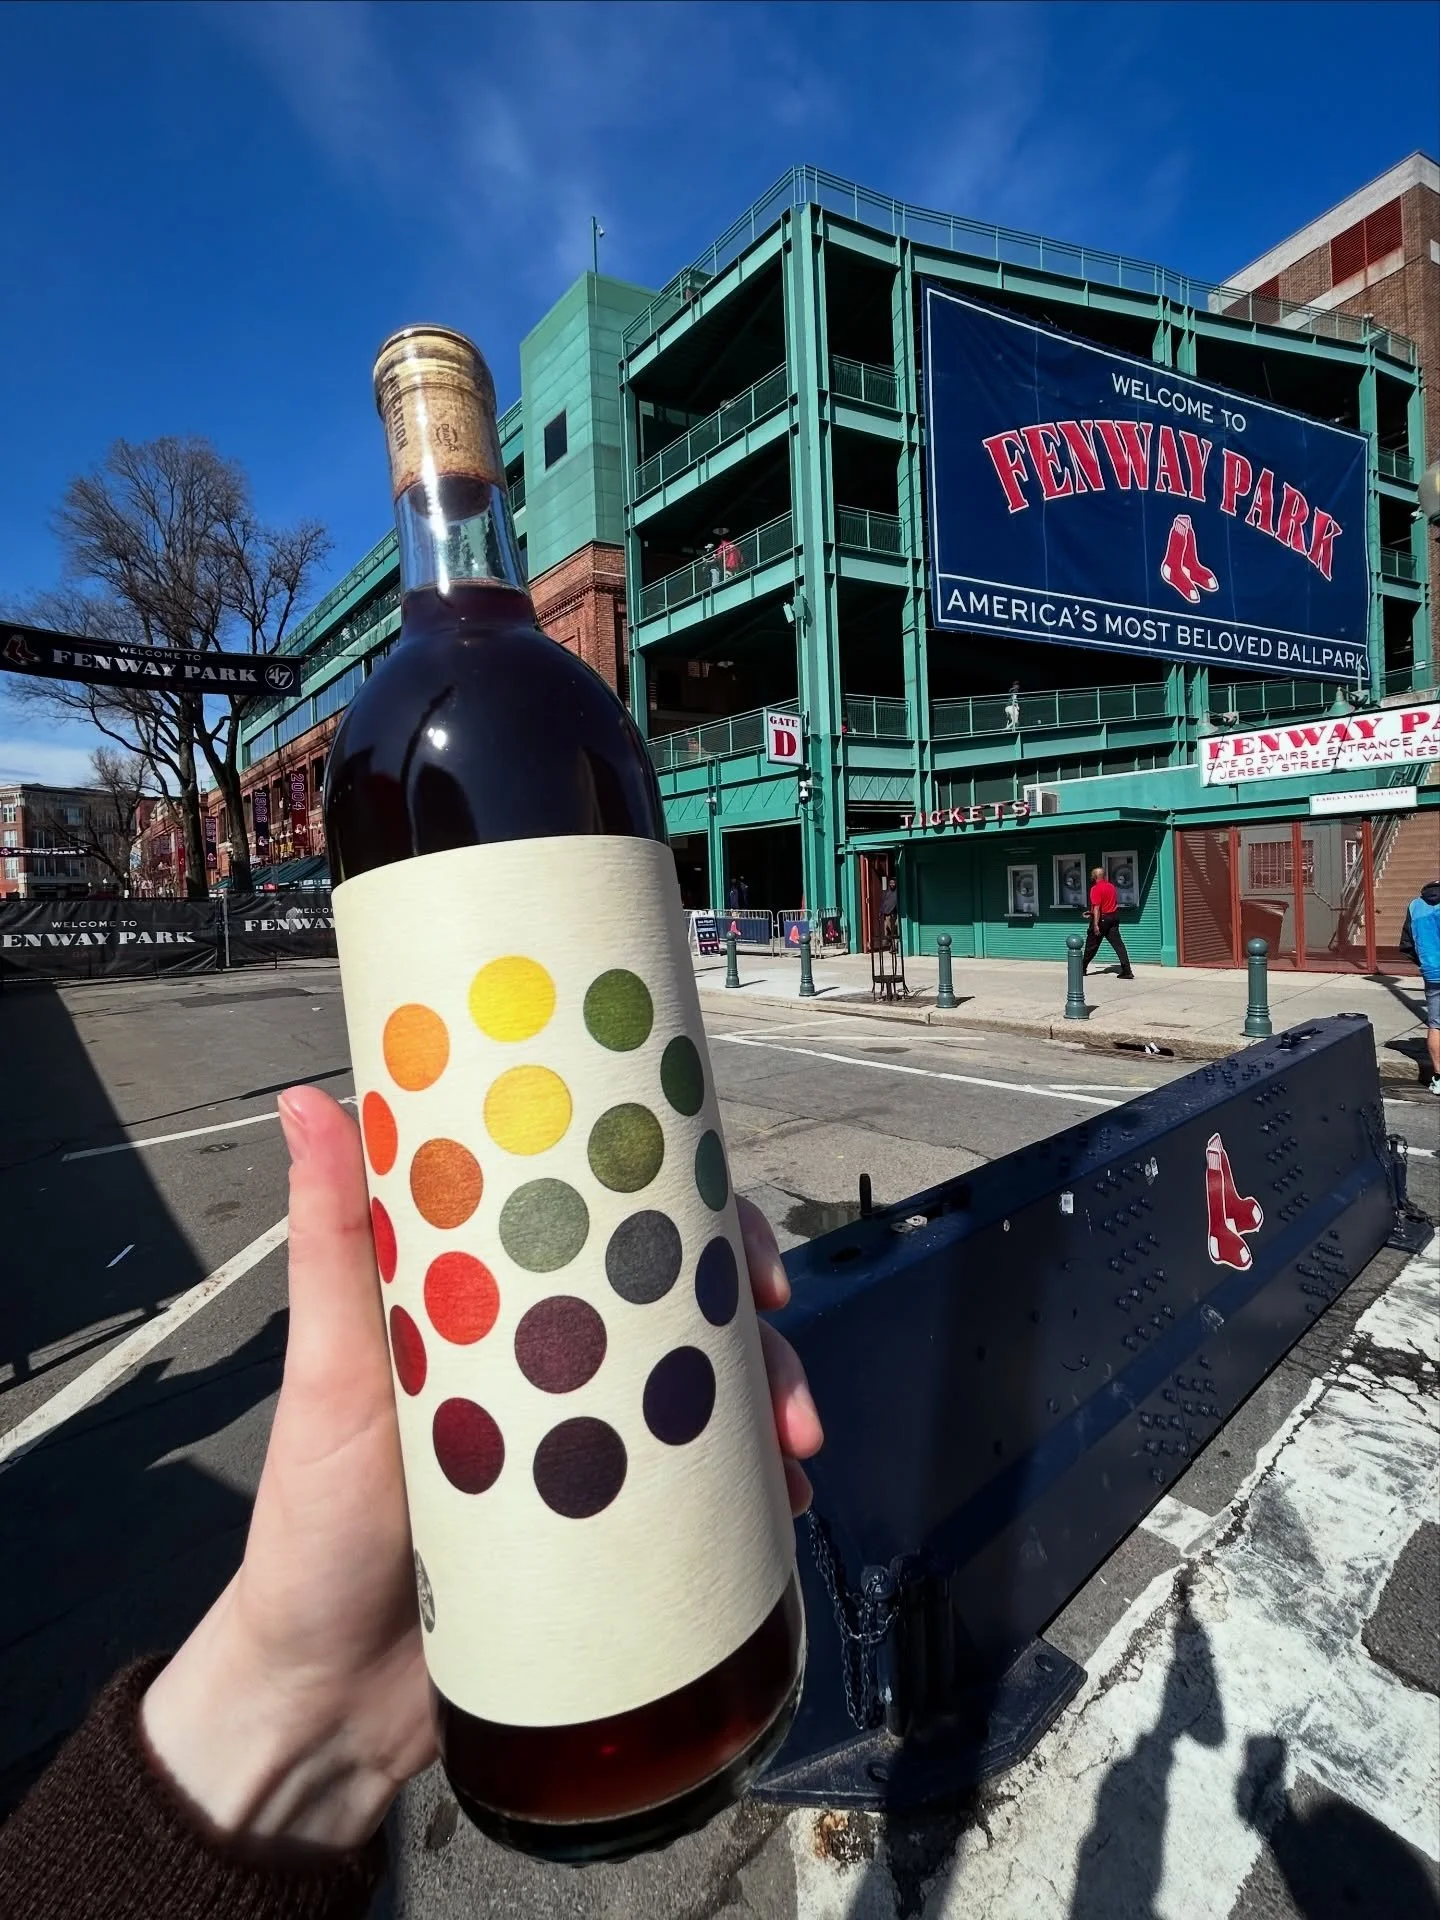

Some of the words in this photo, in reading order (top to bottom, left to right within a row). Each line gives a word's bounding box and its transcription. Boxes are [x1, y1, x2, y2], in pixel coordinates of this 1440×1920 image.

[1112, 373, 1213, 424] WELCOME
[1222, 408, 1247, 432] TO
[983, 419, 1212, 513] FENWAY
[1221, 448, 1342, 581] PARK
[947, 590, 1098, 632] AMERICA'S
[1105, 615, 1171, 643] MOST
[1177, 626, 1273, 657] BELOVED
[1276, 641, 1366, 671] BALLPARK
[52, 649, 176, 677] FENWAY
[184, 665, 258, 682] PARK
[118, 645, 185, 660] WELCOME
[186, 653, 202, 661] TO
[770, 716, 798, 728] GATE
[1208, 717, 1383, 759] FENWAY
[774, 729, 797, 757] D
[1207, 759, 1239, 771] GATE
[1246, 757, 1254, 767] D
[1261, 751, 1309, 764] STAIRS
[1328, 737, 1413, 756] ENTRANCE
[1220, 766, 1274, 780] JERSEY
[1281, 757, 1339, 772] STREET
[1363, 751, 1393, 762] VAN
[1404, 745, 1439, 758] NES
[291, 773, 305, 811] 2004
[900, 800, 1030, 829] TICKETS
[51, 920, 117, 928] WELCOME
[118, 931, 196, 945] PARK
